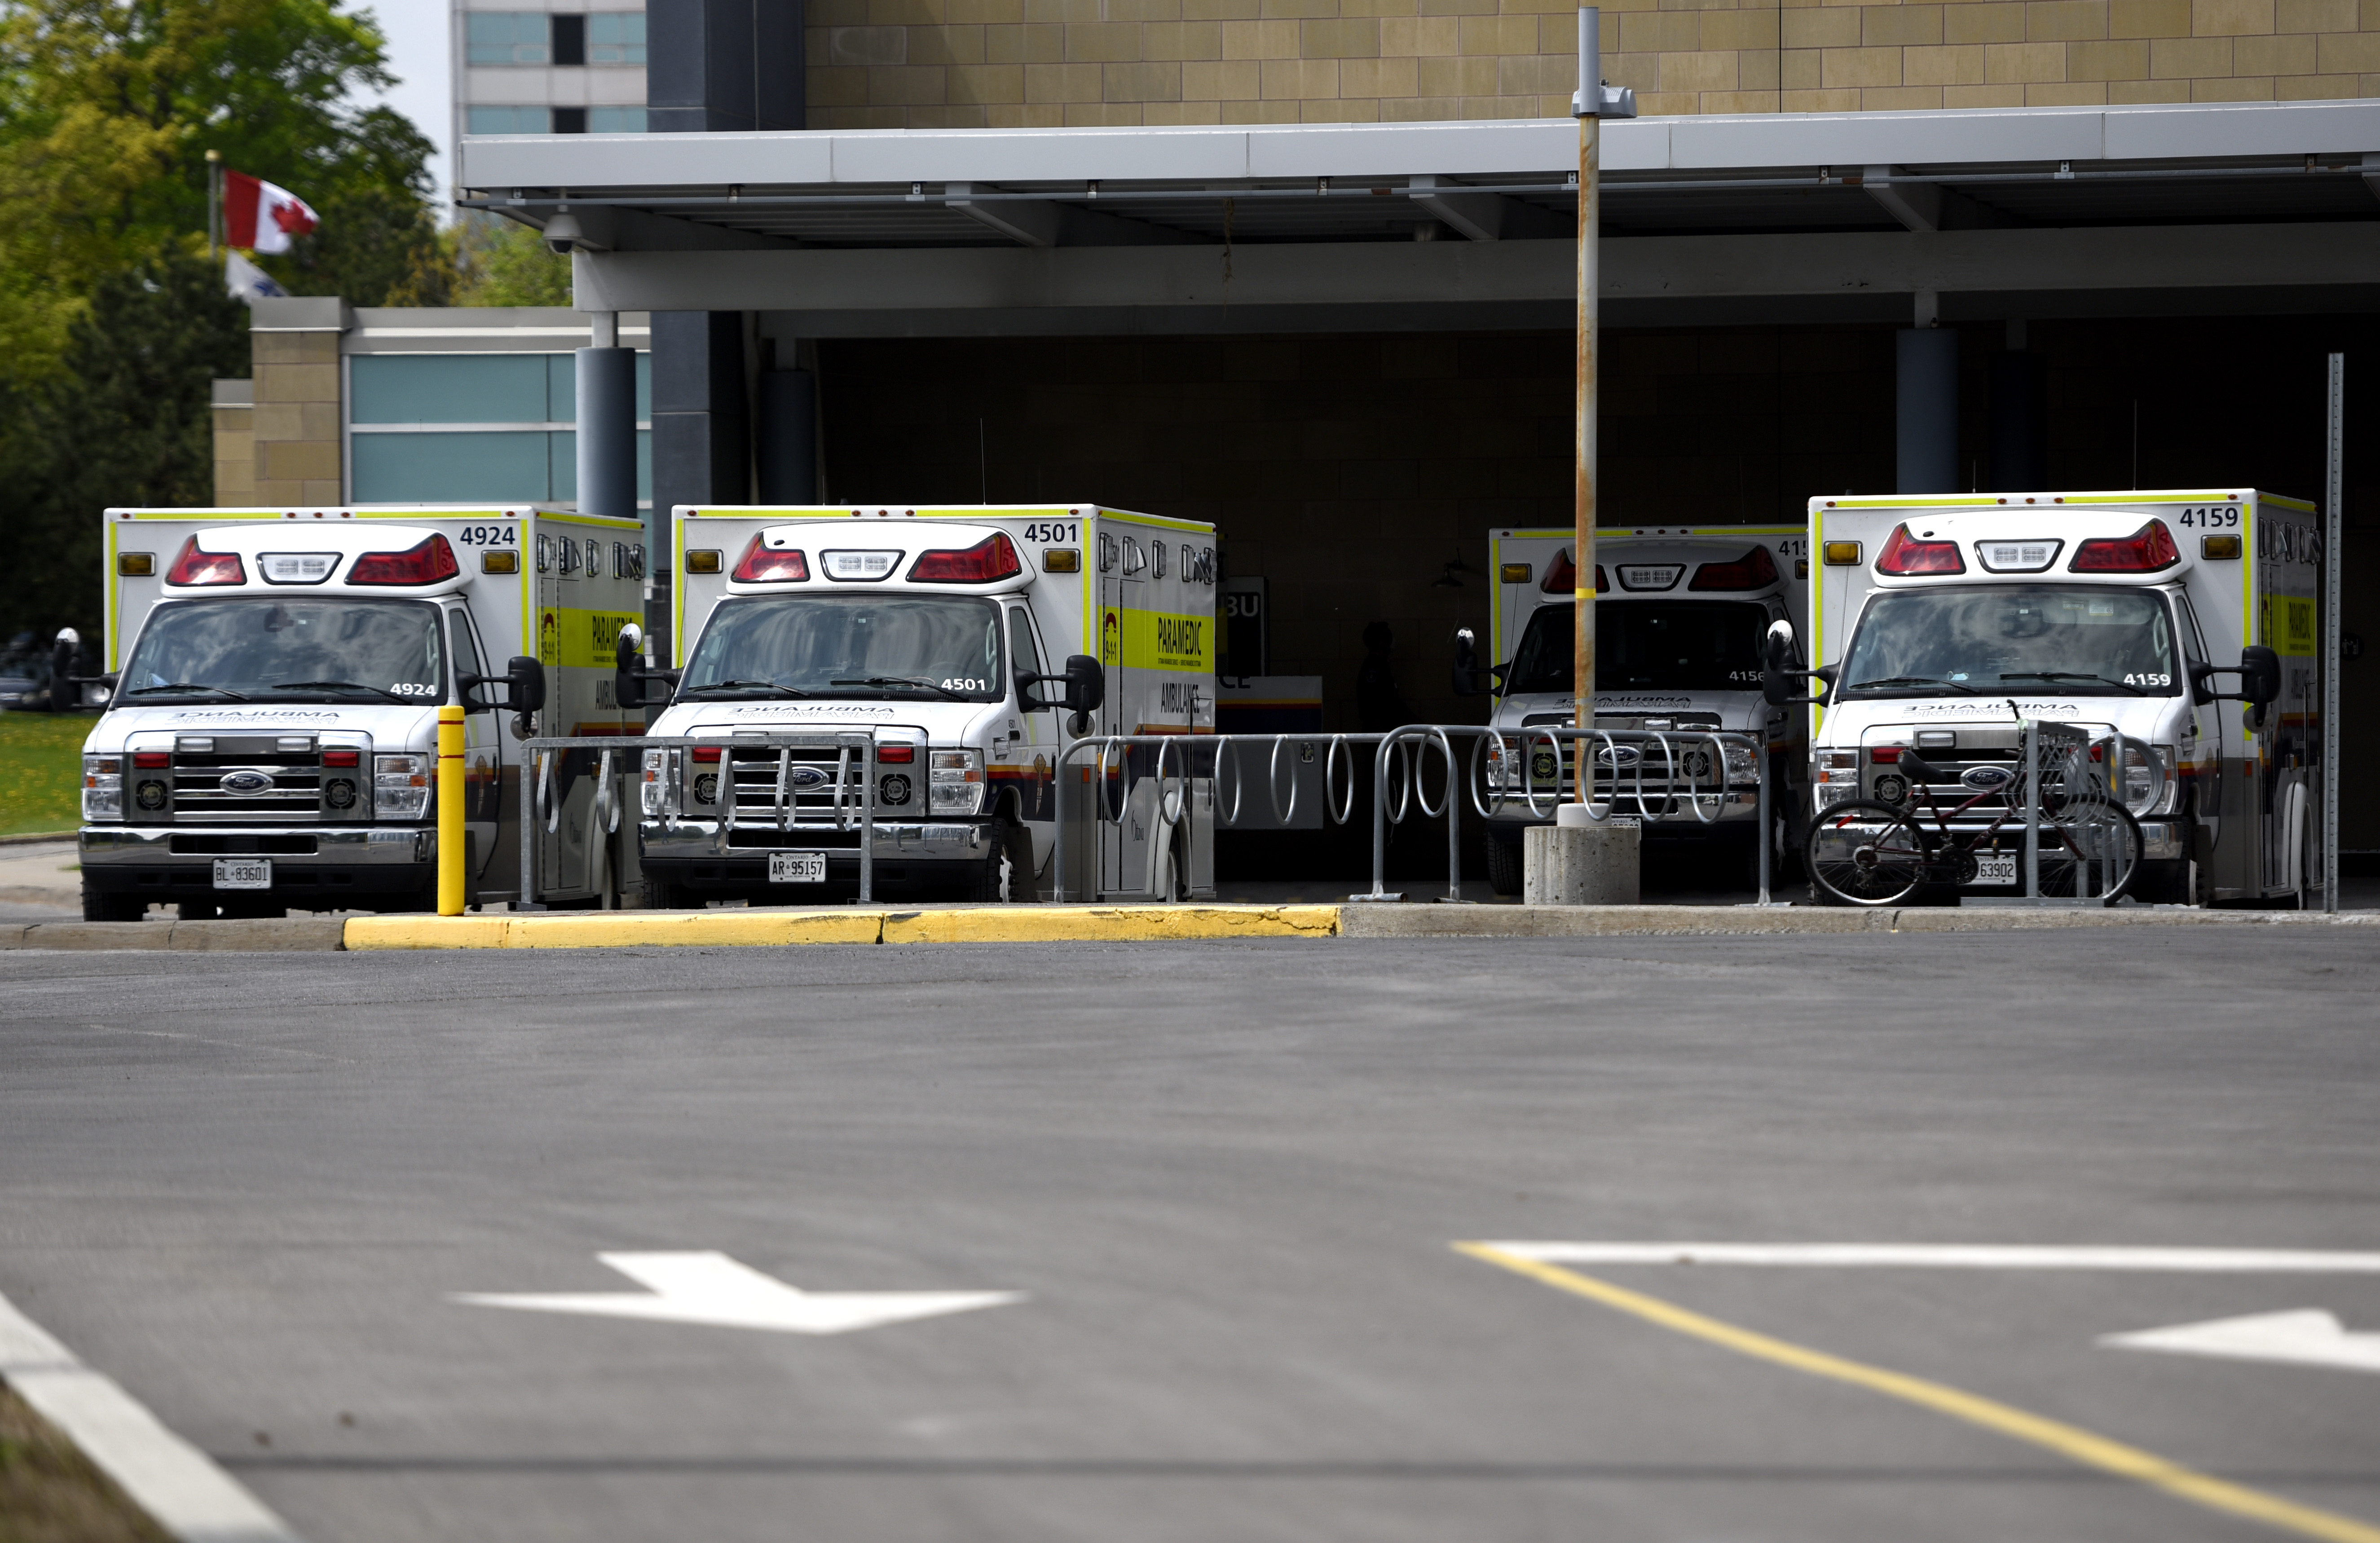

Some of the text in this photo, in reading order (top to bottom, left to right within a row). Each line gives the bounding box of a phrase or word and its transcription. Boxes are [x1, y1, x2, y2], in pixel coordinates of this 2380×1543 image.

[2180, 507, 2238, 527] 4159
[460, 527, 515, 545] 4924
[1025, 524, 1076, 542] 4501
[1158, 617, 1202, 656] PARAMEDIC
[1106, 640, 1116, 660] 9-1-1
[941, 679, 985, 690] 4501
[2124, 674, 2171, 686] 4159
[390, 683, 437, 696] 4924
[1161, 683, 1200, 713] AMBULANCE
[234, 777, 256, 786] Ford
[1975, 772, 1999, 782] Ford
[236, 867, 267, 881] 83601
[772, 861, 823, 875] AR 95157
[1981, 863, 2014, 877] 63902
